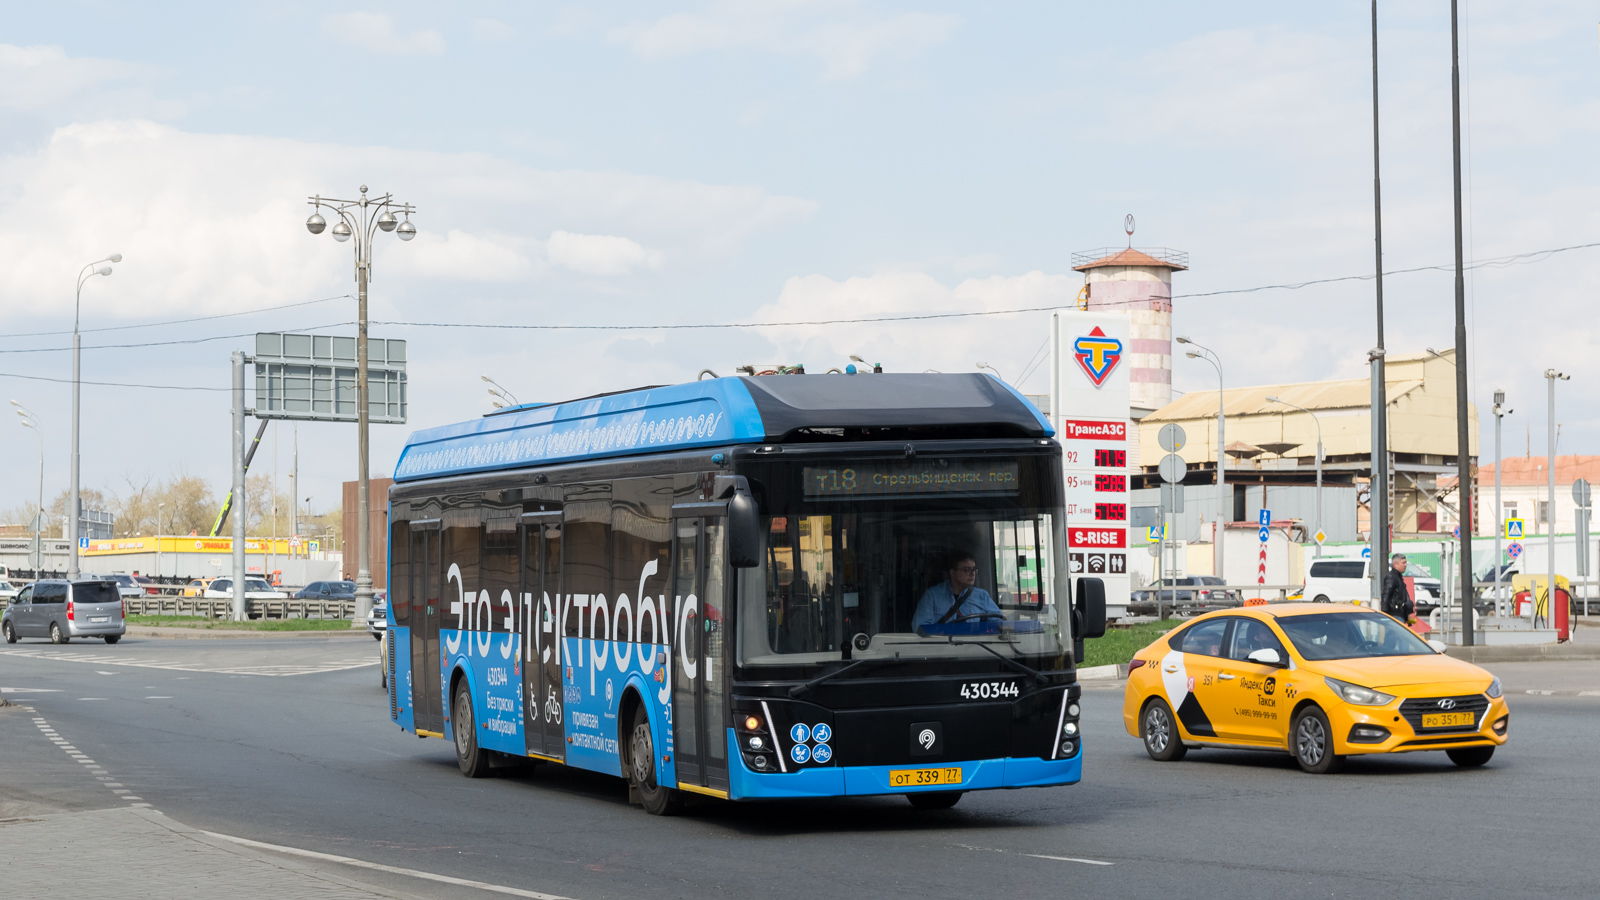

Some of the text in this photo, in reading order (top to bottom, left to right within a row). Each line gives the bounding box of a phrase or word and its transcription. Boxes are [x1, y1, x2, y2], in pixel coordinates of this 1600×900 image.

[1068, 423, 1124, 436] ТрансАЗС
[1067, 451, 1078, 463] 92
[989, 471, 1016, 483] пер.
[1067, 476, 1078, 488] 95
[1067, 504, 1078, 516] ДТ
[1074, 531, 1118, 545] S-RISE
[446, 563, 492, 659] Это
[487, 667, 507, 686] 430344
[1203, 675, 1213, 686] 351
[960, 682, 1019, 699] 430344
[1240, 677, 1275, 692] Яндекс Go
[1257, 694, 1276, 707] Такси
[1240, 708, 1252, 717] (495)
[572, 711, 599, 730] привязан
[916, 771, 939, 783] 339
[946, 769, 958, 779] 77
